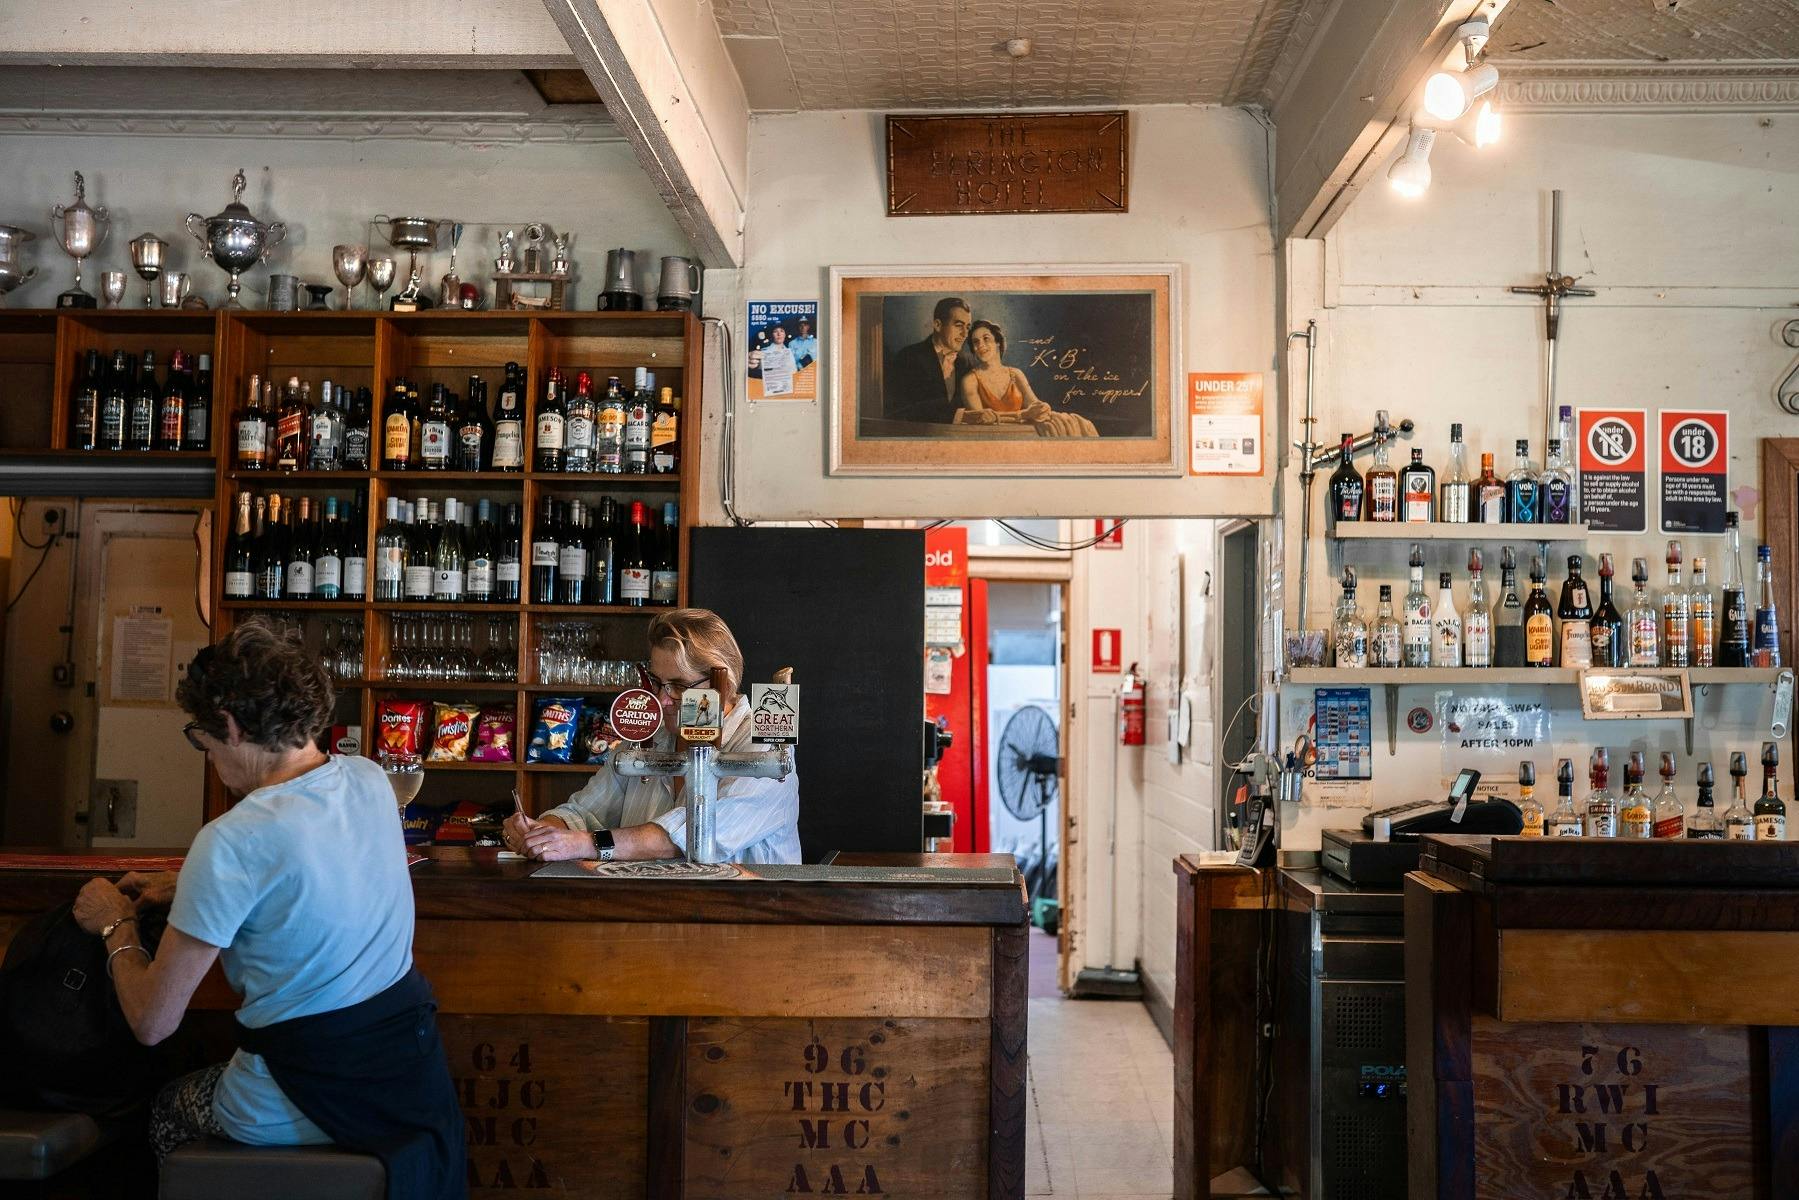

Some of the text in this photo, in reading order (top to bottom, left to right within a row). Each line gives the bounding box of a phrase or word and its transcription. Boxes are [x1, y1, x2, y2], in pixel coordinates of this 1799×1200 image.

[983, 121, 1034, 147] THE
[929, 147, 1103, 177] ELRINGTON
[956, 179, 1048, 206] HOTEL
[751, 304, 816, 314] NO EXCUSE!
[1104, 370, 1121, 381] ice
[1195, 380, 1234, 392] UNDER
[1062, 386, 1086, 404] for
[1682, 427, 1705, 436] under
[1599, 434, 1624, 457] 18
[1681, 436, 1706, 458] 18
[1519, 482, 1532, 491] vok
[1550, 482, 1564, 491] vok
[1636, 680, 1680, 692] BRANDY
[382, 714, 411, 723] Doritos
[615, 709, 657, 720] CARLTON
[754, 714, 795, 725] GREAT
[438, 722, 468, 738] Twisties
[1461, 738, 1533, 748] AFTER 10PM
